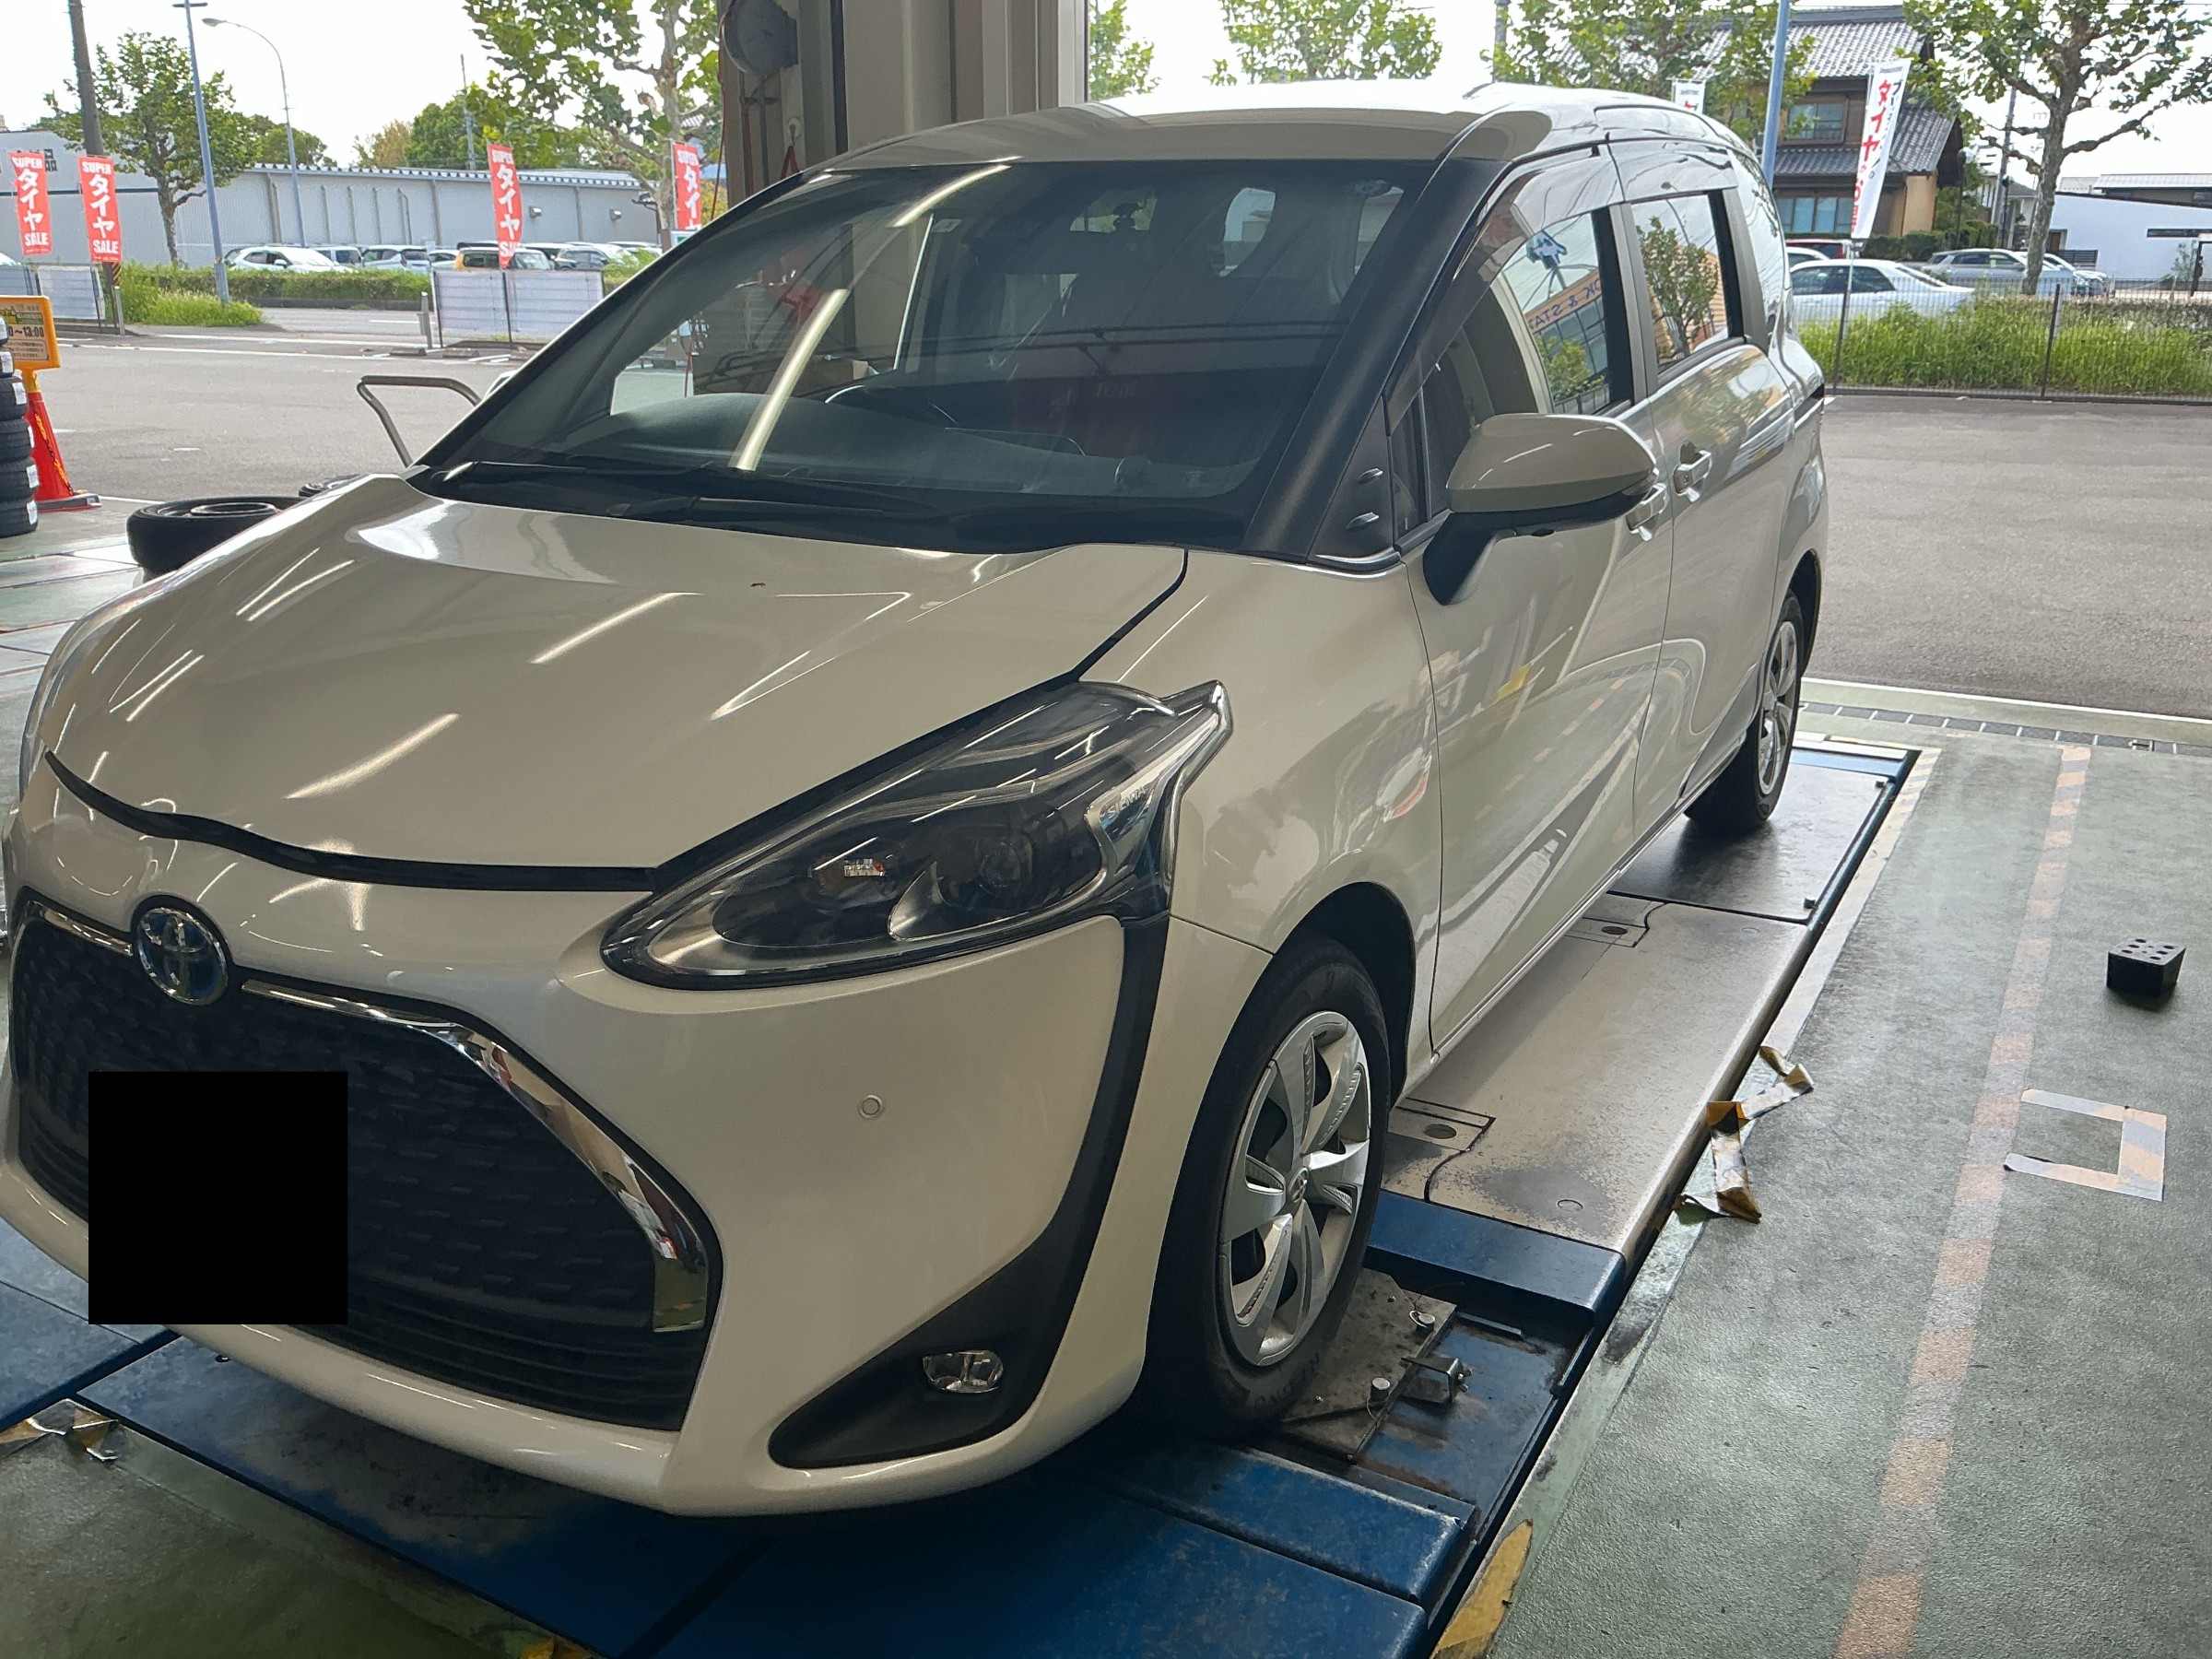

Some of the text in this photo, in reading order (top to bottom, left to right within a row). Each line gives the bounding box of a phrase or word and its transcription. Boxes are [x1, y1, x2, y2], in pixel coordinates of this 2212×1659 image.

[11, 157, 42, 169] SUPER
[81, 161, 112, 175] SUPER
[18, 169, 44, 231] タイヤ
[89, 174, 115, 239] タイヤ
[497, 164, 520, 241] タイヤ
[24, 232, 49, 247] SALE
[92, 240, 119, 254] SALE
